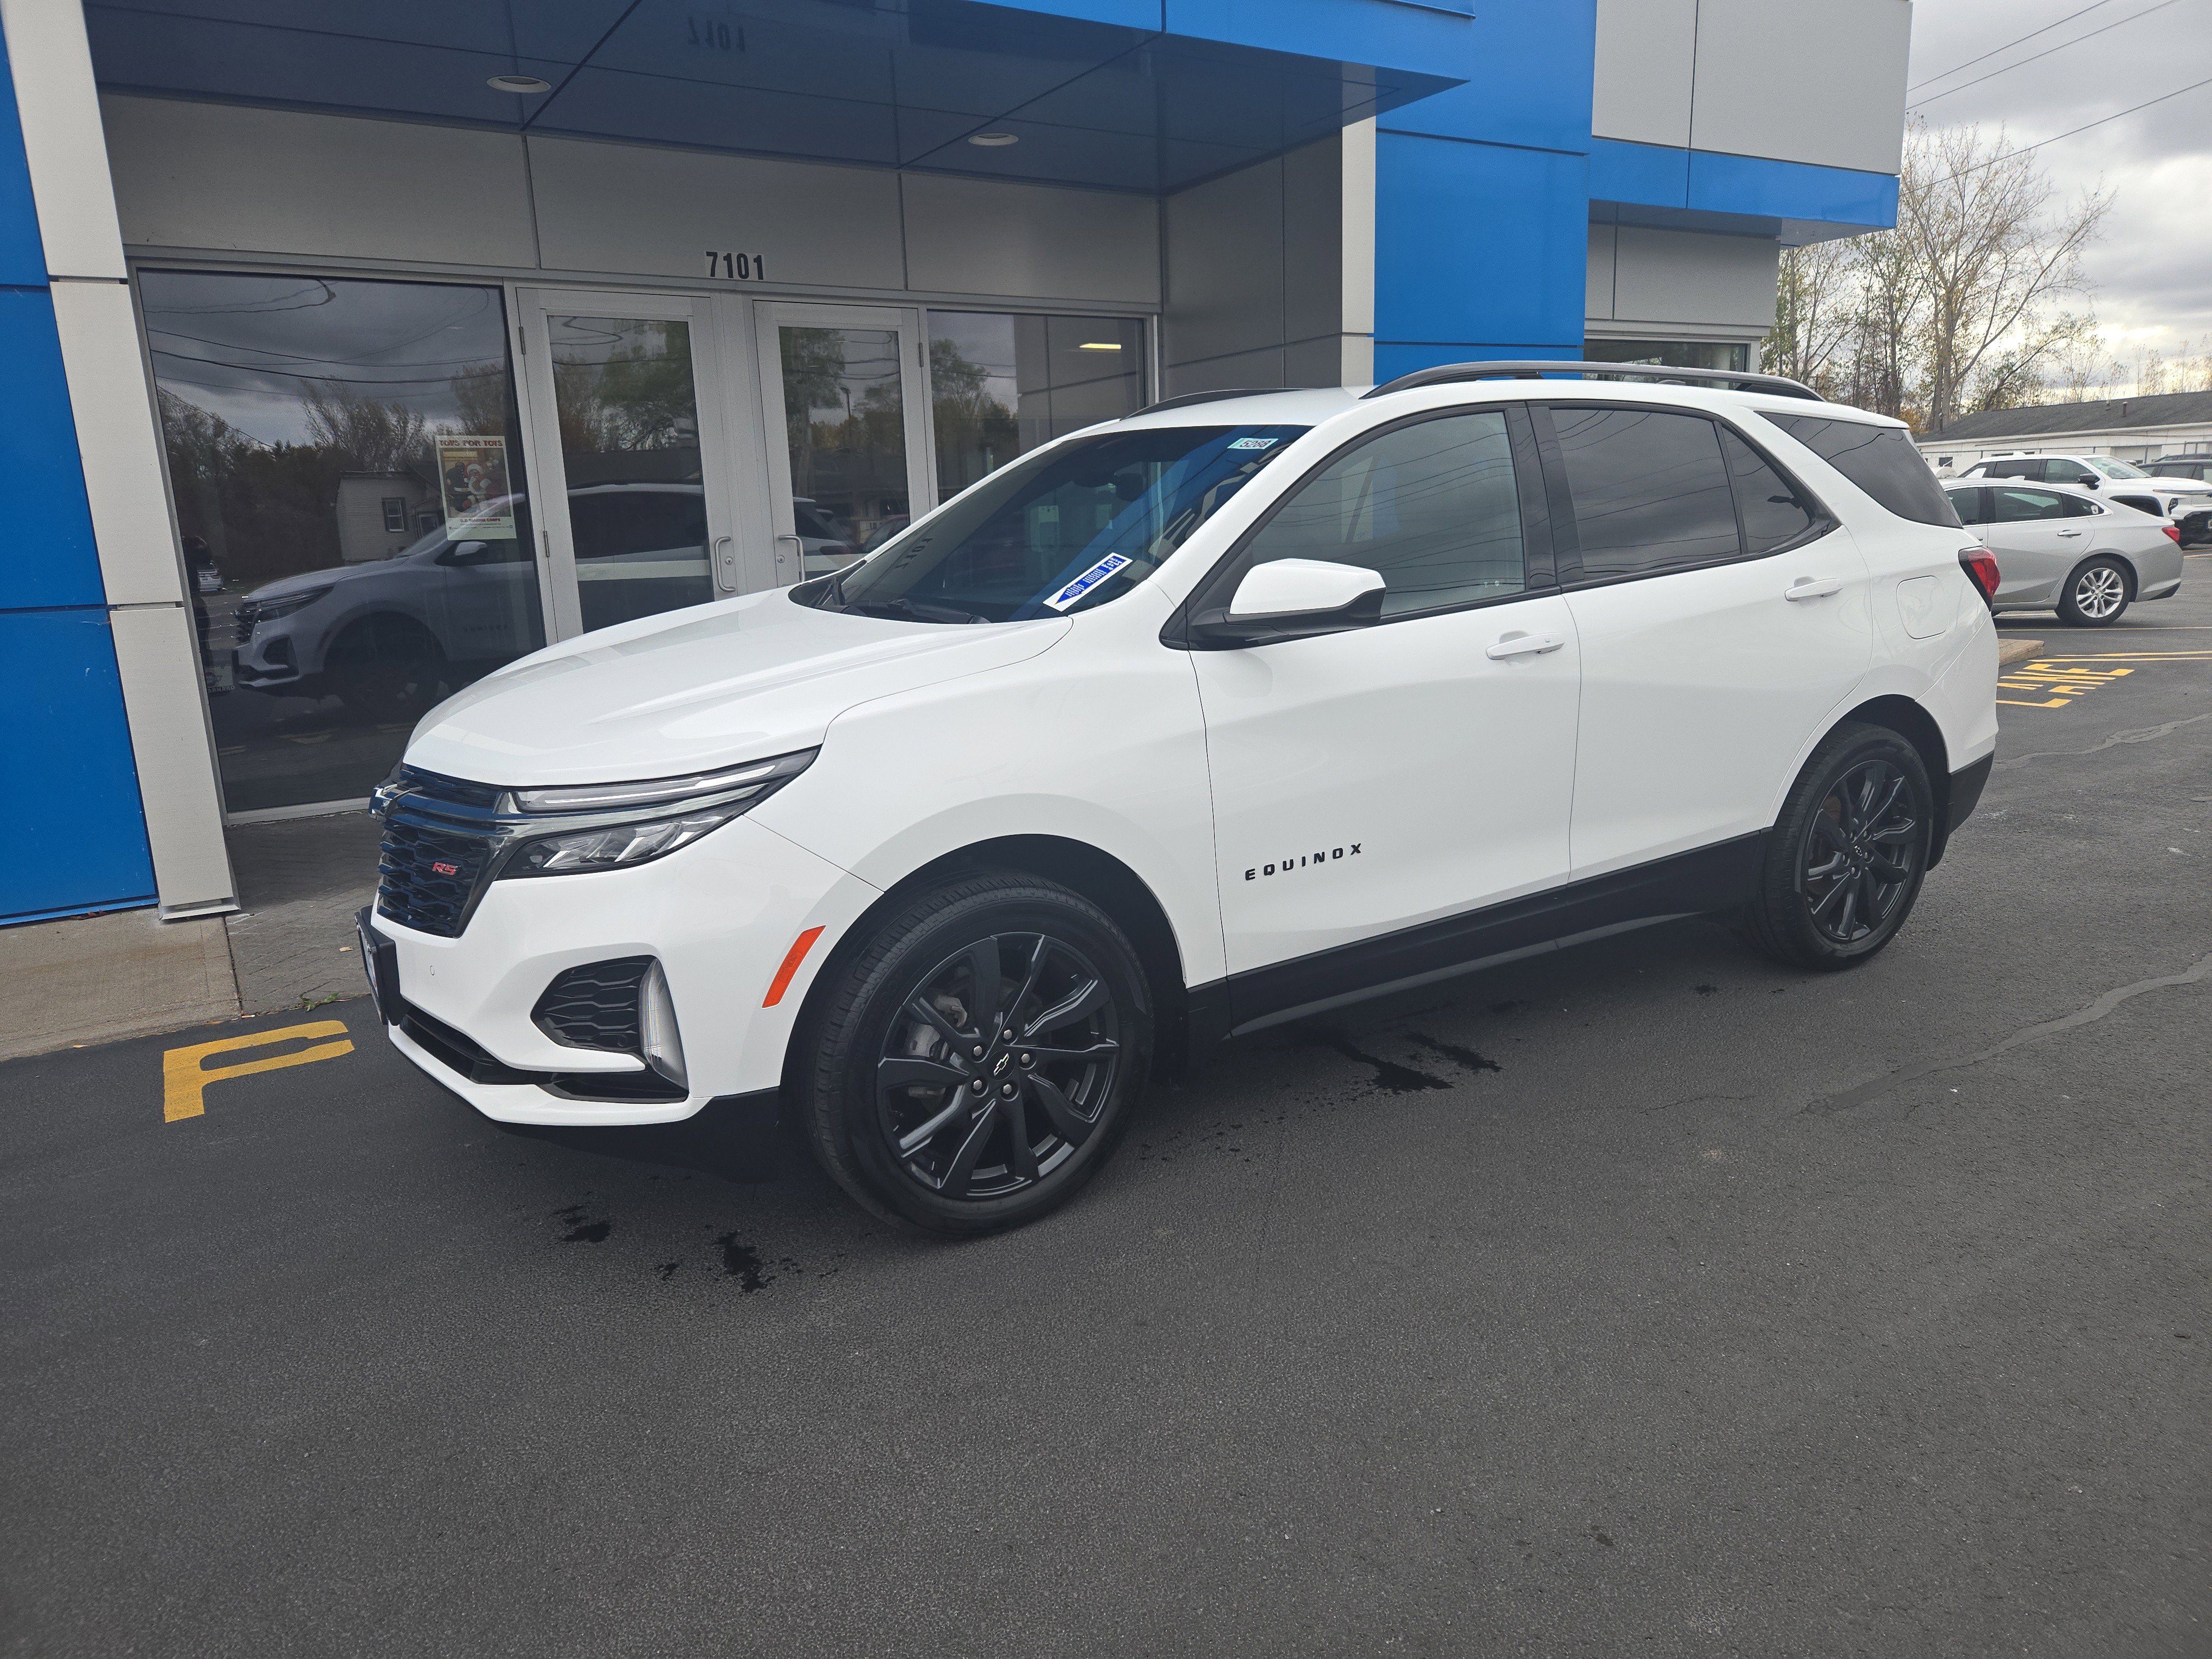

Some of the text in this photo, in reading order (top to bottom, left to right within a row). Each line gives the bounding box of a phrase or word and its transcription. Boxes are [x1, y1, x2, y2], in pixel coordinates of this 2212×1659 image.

[706, 251, 763, 280] 7101
[432, 861, 459, 876] RS
[1245, 843, 1361, 880] EQUINOX
